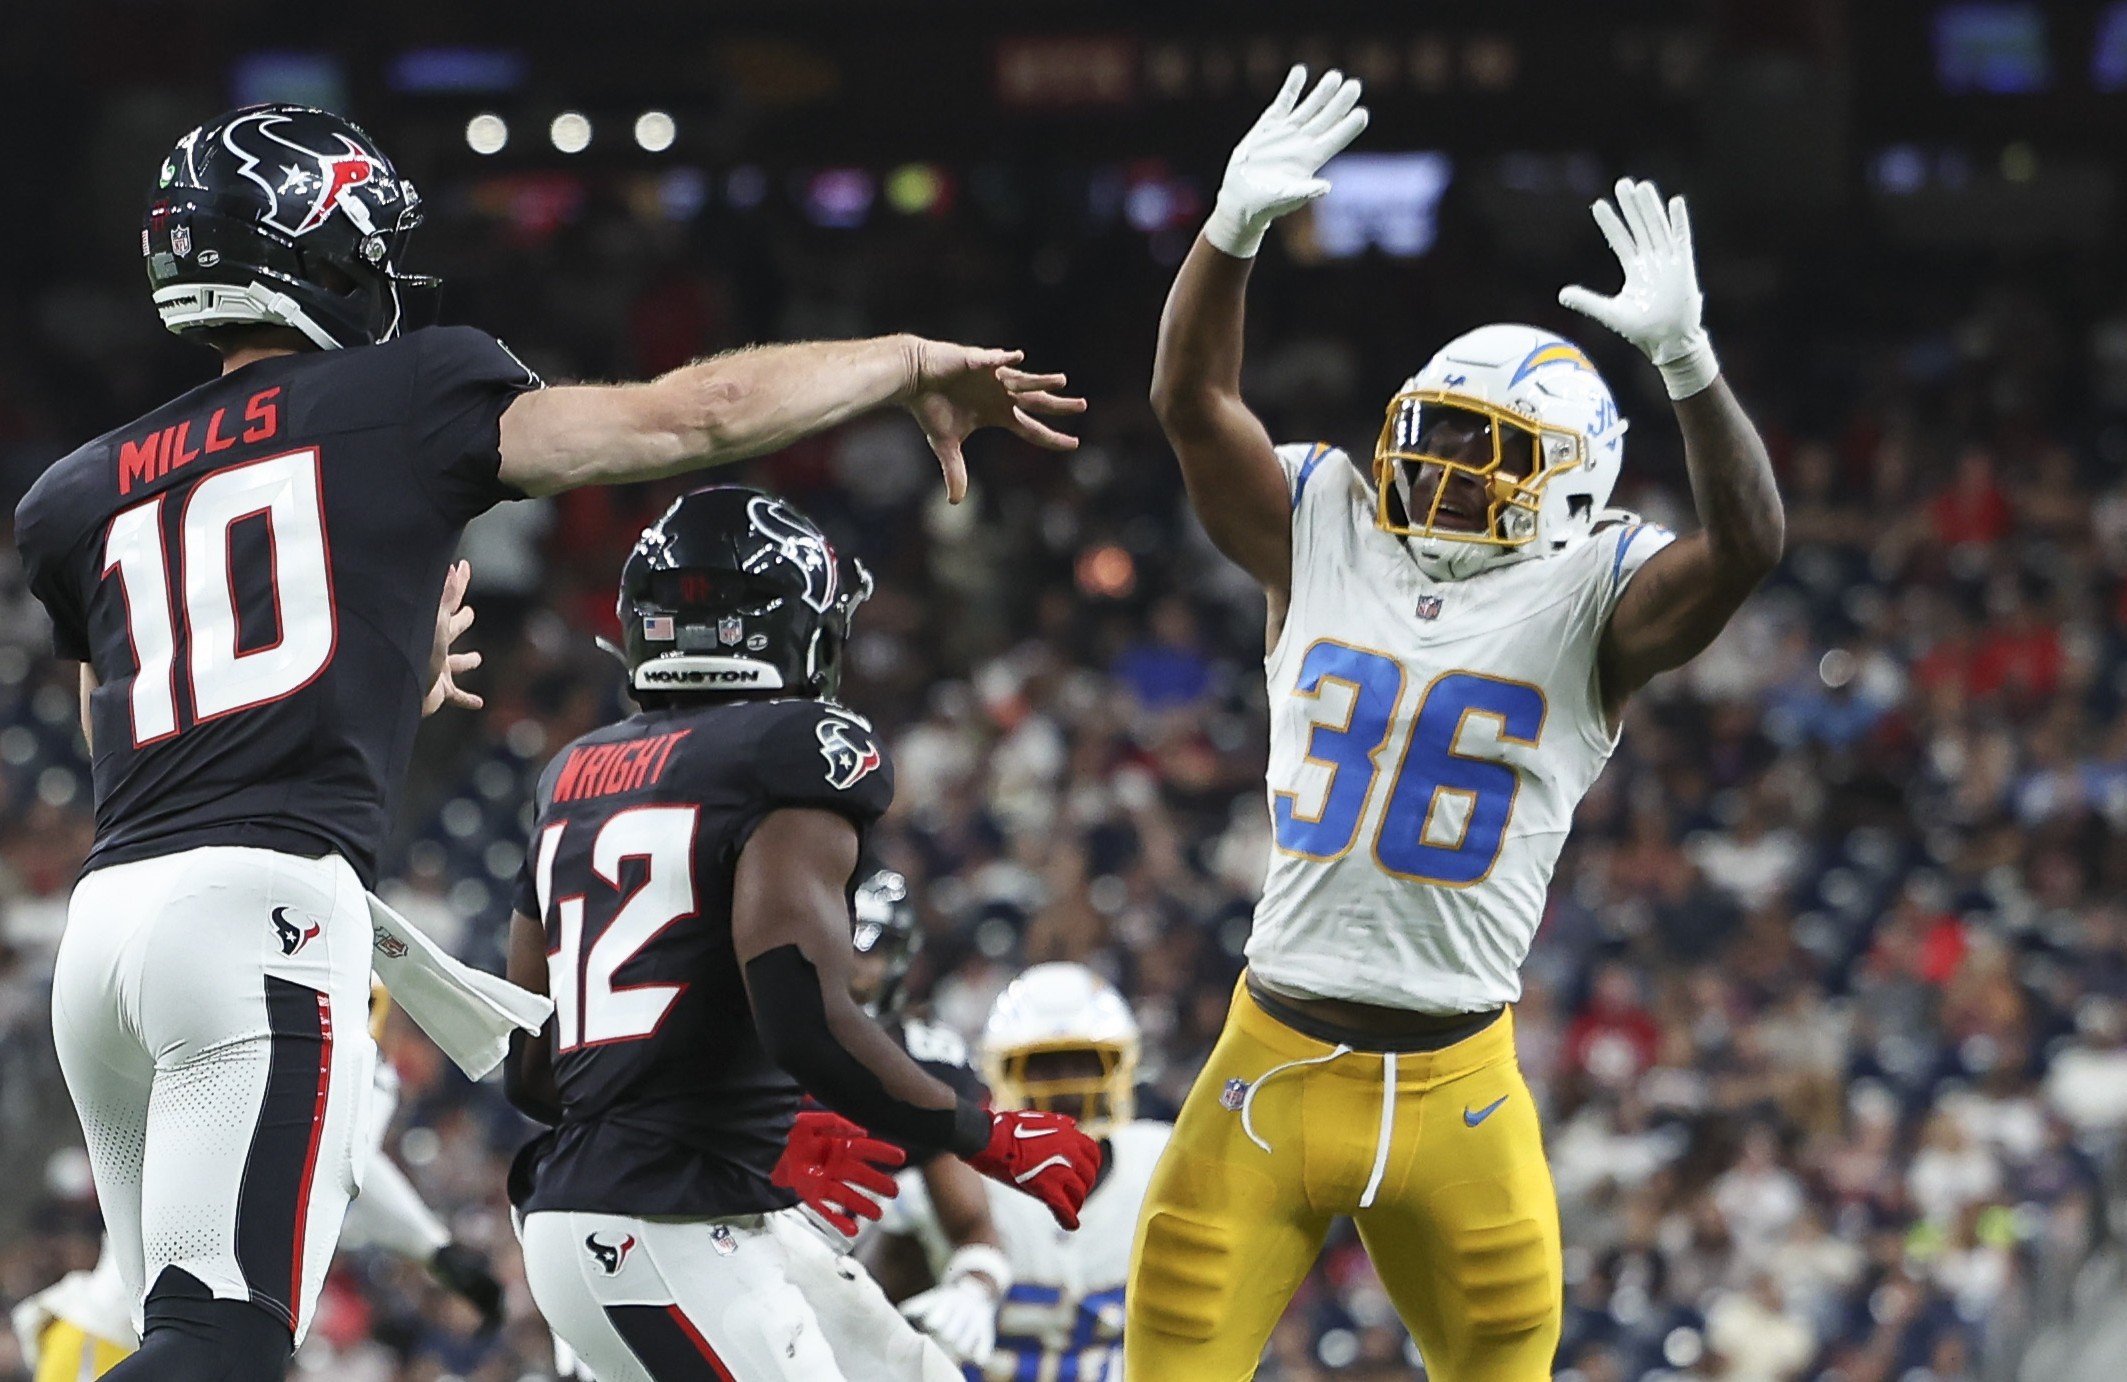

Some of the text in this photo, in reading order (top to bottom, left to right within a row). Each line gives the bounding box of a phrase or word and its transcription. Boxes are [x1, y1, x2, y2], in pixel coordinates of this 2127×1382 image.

[118, 386, 281, 496] MILLS
[101, 444, 339, 750] 10
[643, 670, 760, 684] HOUSTON
[553, 728, 692, 803] WRIGHT
[1273, 636, 1548, 889] 36
[535, 802, 701, 1054] 42
